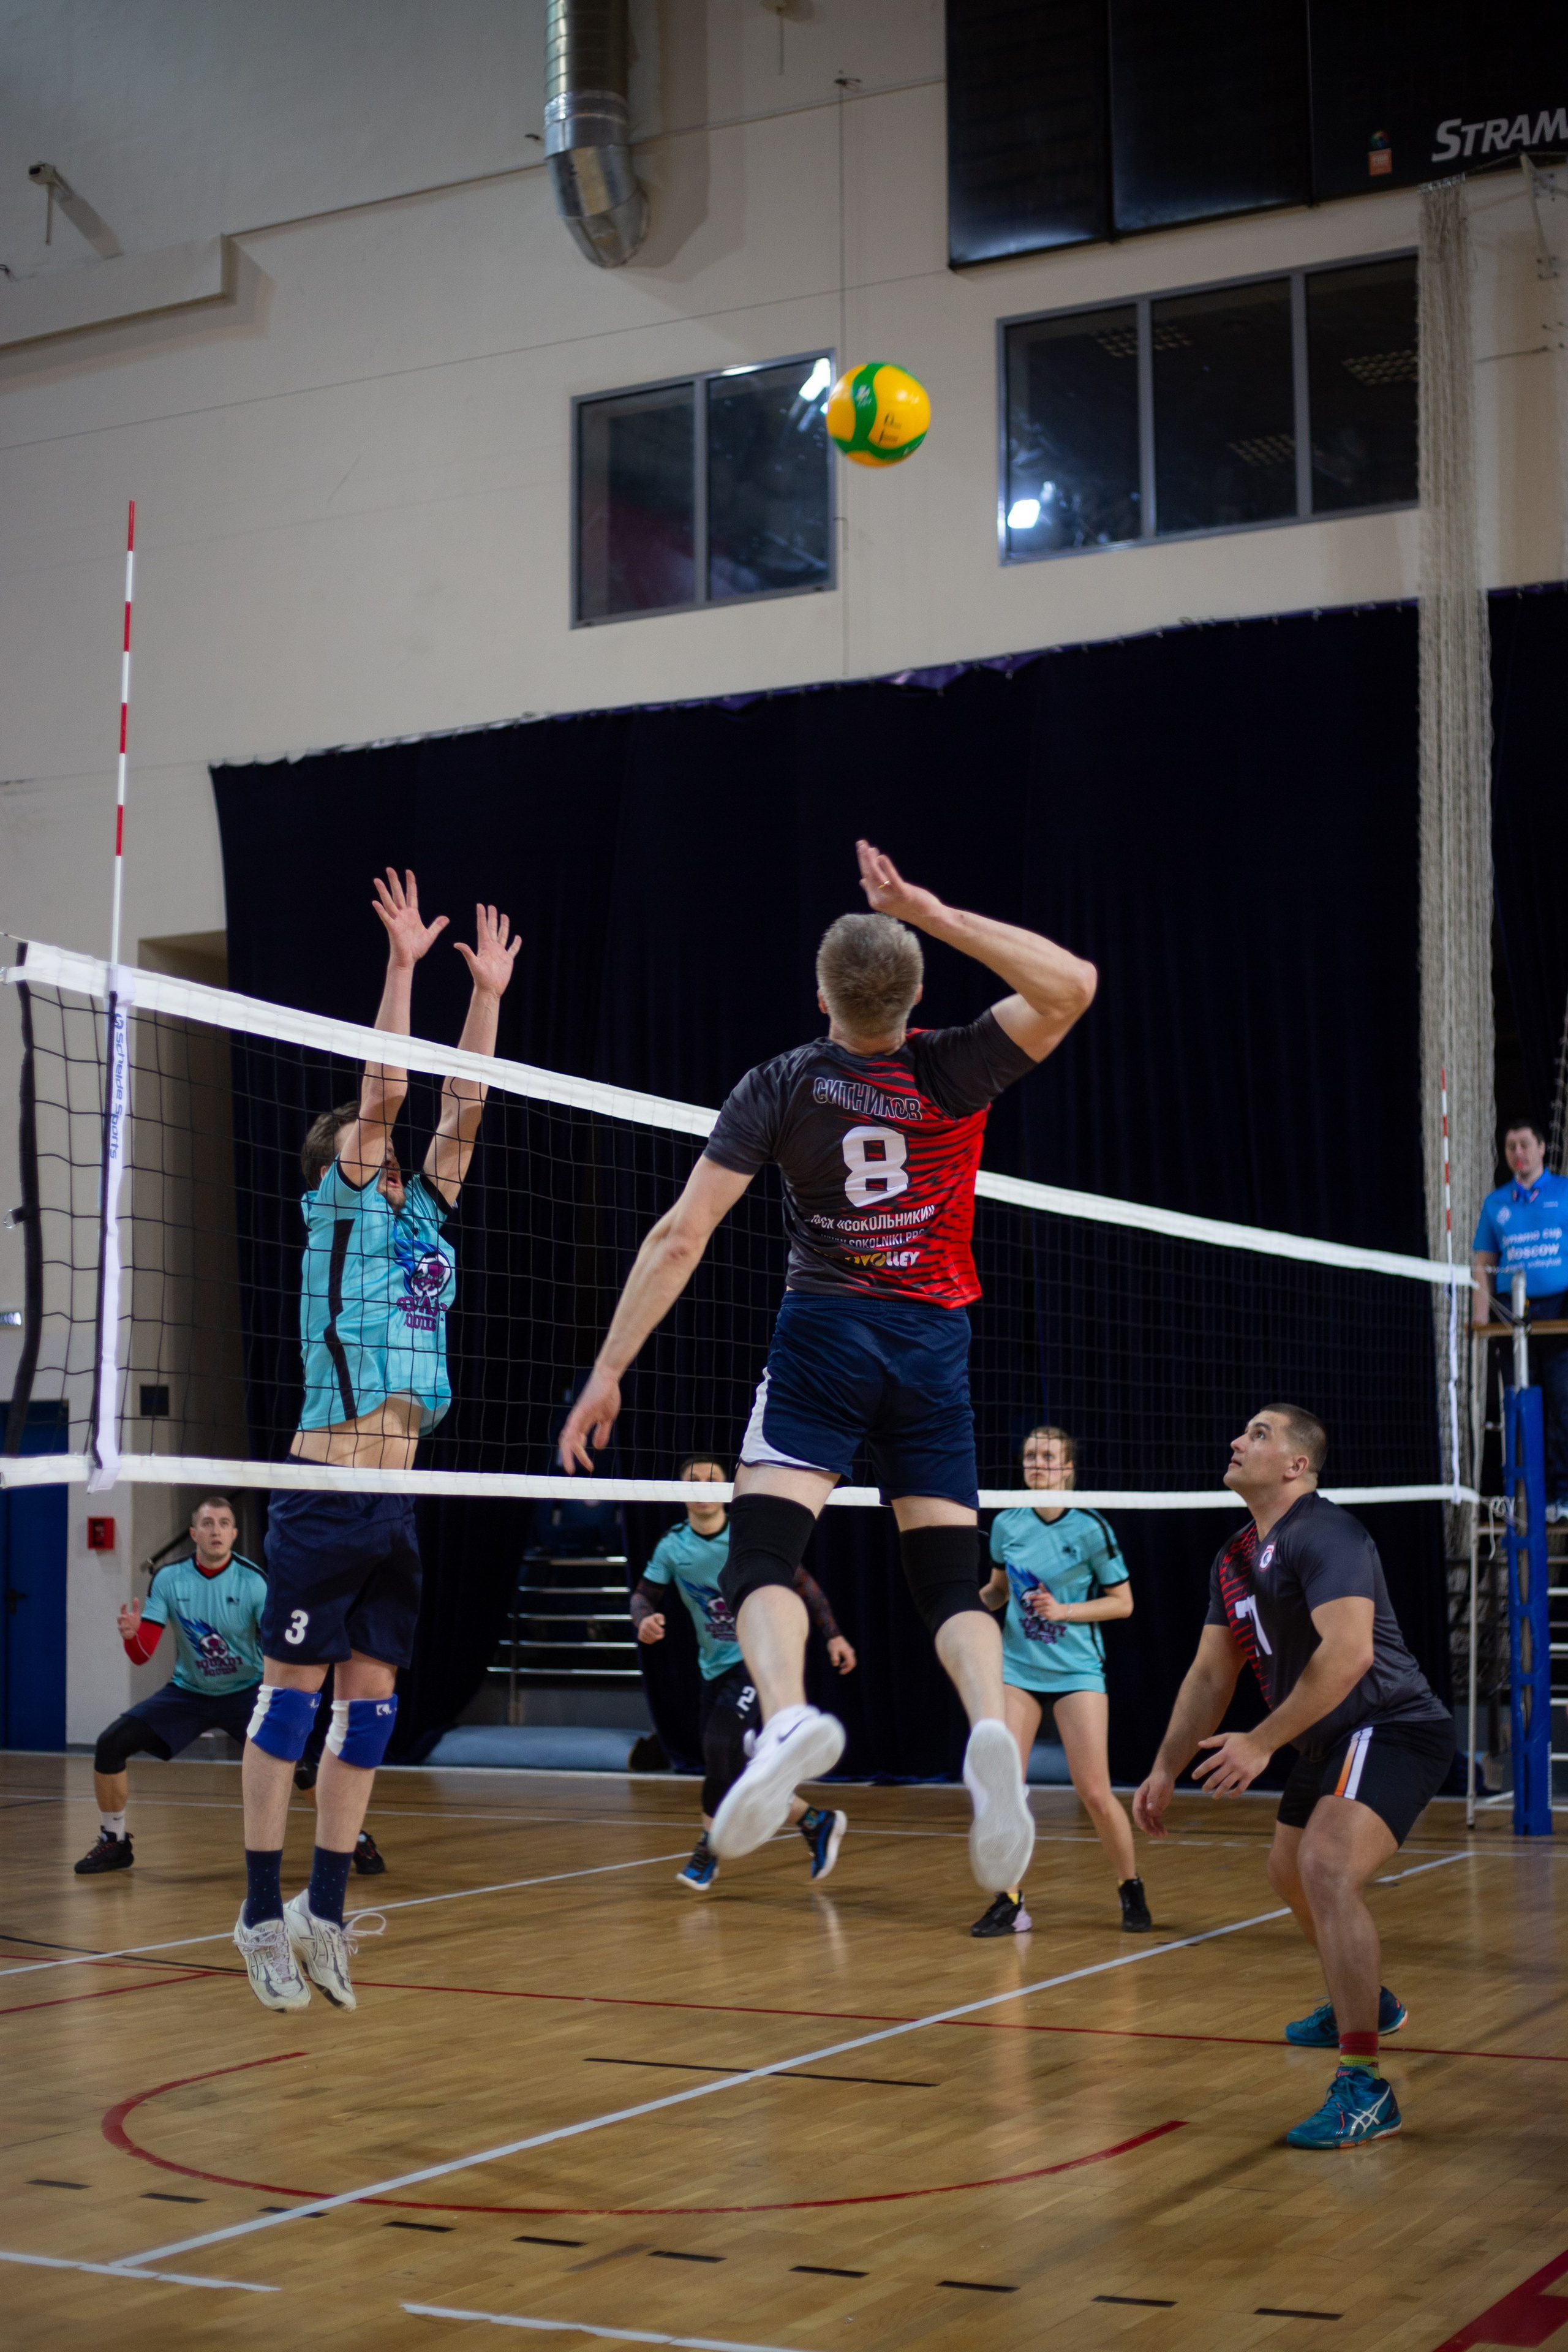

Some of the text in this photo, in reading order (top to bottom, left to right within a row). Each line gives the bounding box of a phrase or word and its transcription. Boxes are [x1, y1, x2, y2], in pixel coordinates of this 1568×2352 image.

[1431, 107, 1568, 163] STRAM
[813, 1077, 922, 1121] СИТНИКОВ
[110, 1104, 123, 1159] Sports
[842, 1126, 909, 1208] 8
[285, 1609, 309, 1645] 3
[736, 1686, 756, 1712] 2
